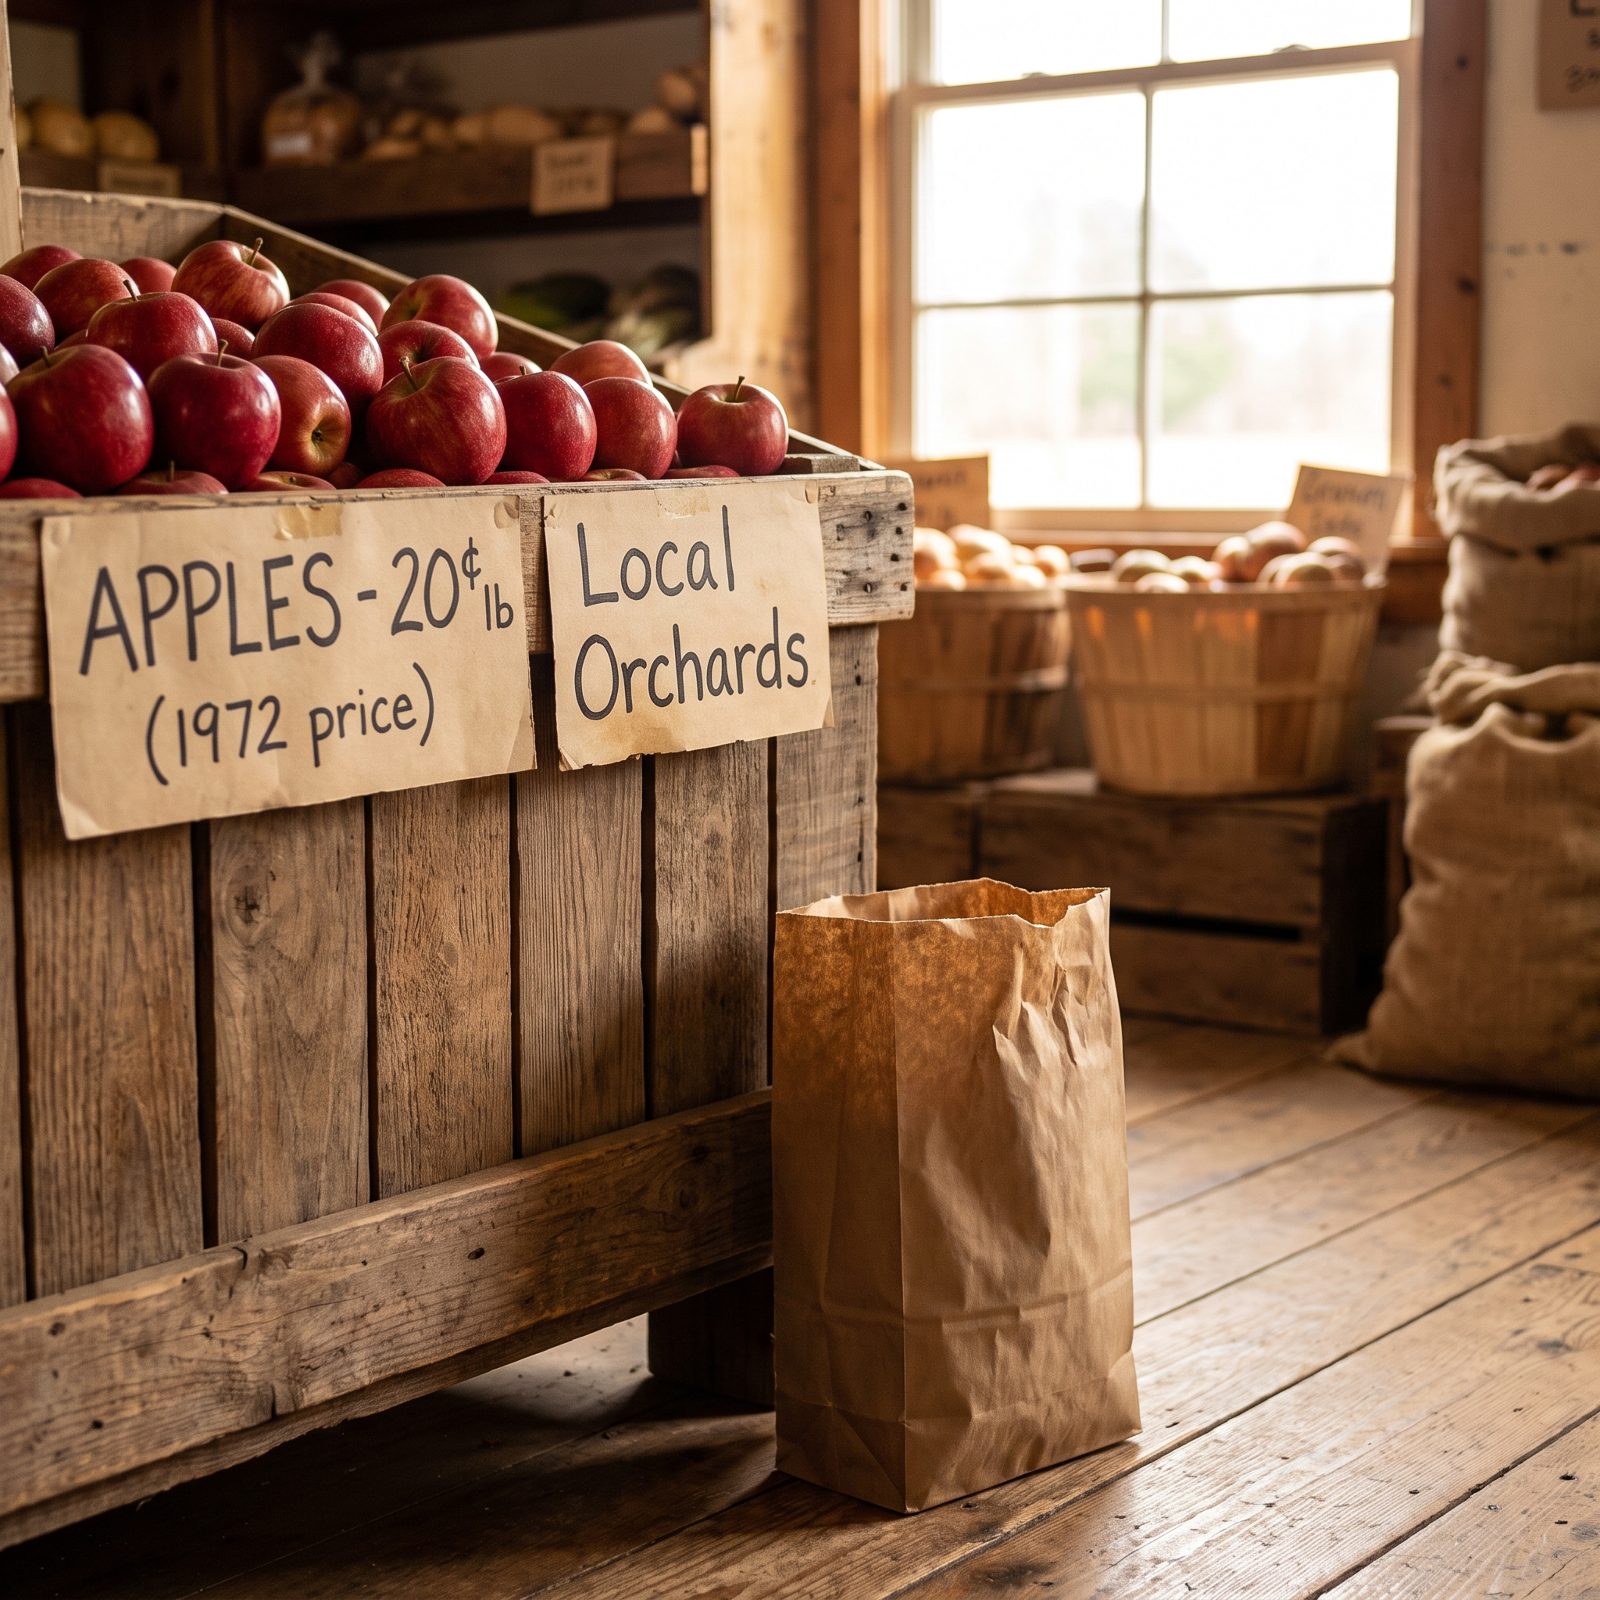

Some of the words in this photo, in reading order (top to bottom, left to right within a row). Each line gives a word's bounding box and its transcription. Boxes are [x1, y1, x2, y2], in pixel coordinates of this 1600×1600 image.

[78, 551, 342, 677] APPLES
[484, 582, 514, 632] lb
[576, 504, 735, 608] Local
[574, 606, 809, 721] Orchards
[145, 694, 288, 787] (1972
[308, 662, 435, 769] price)
